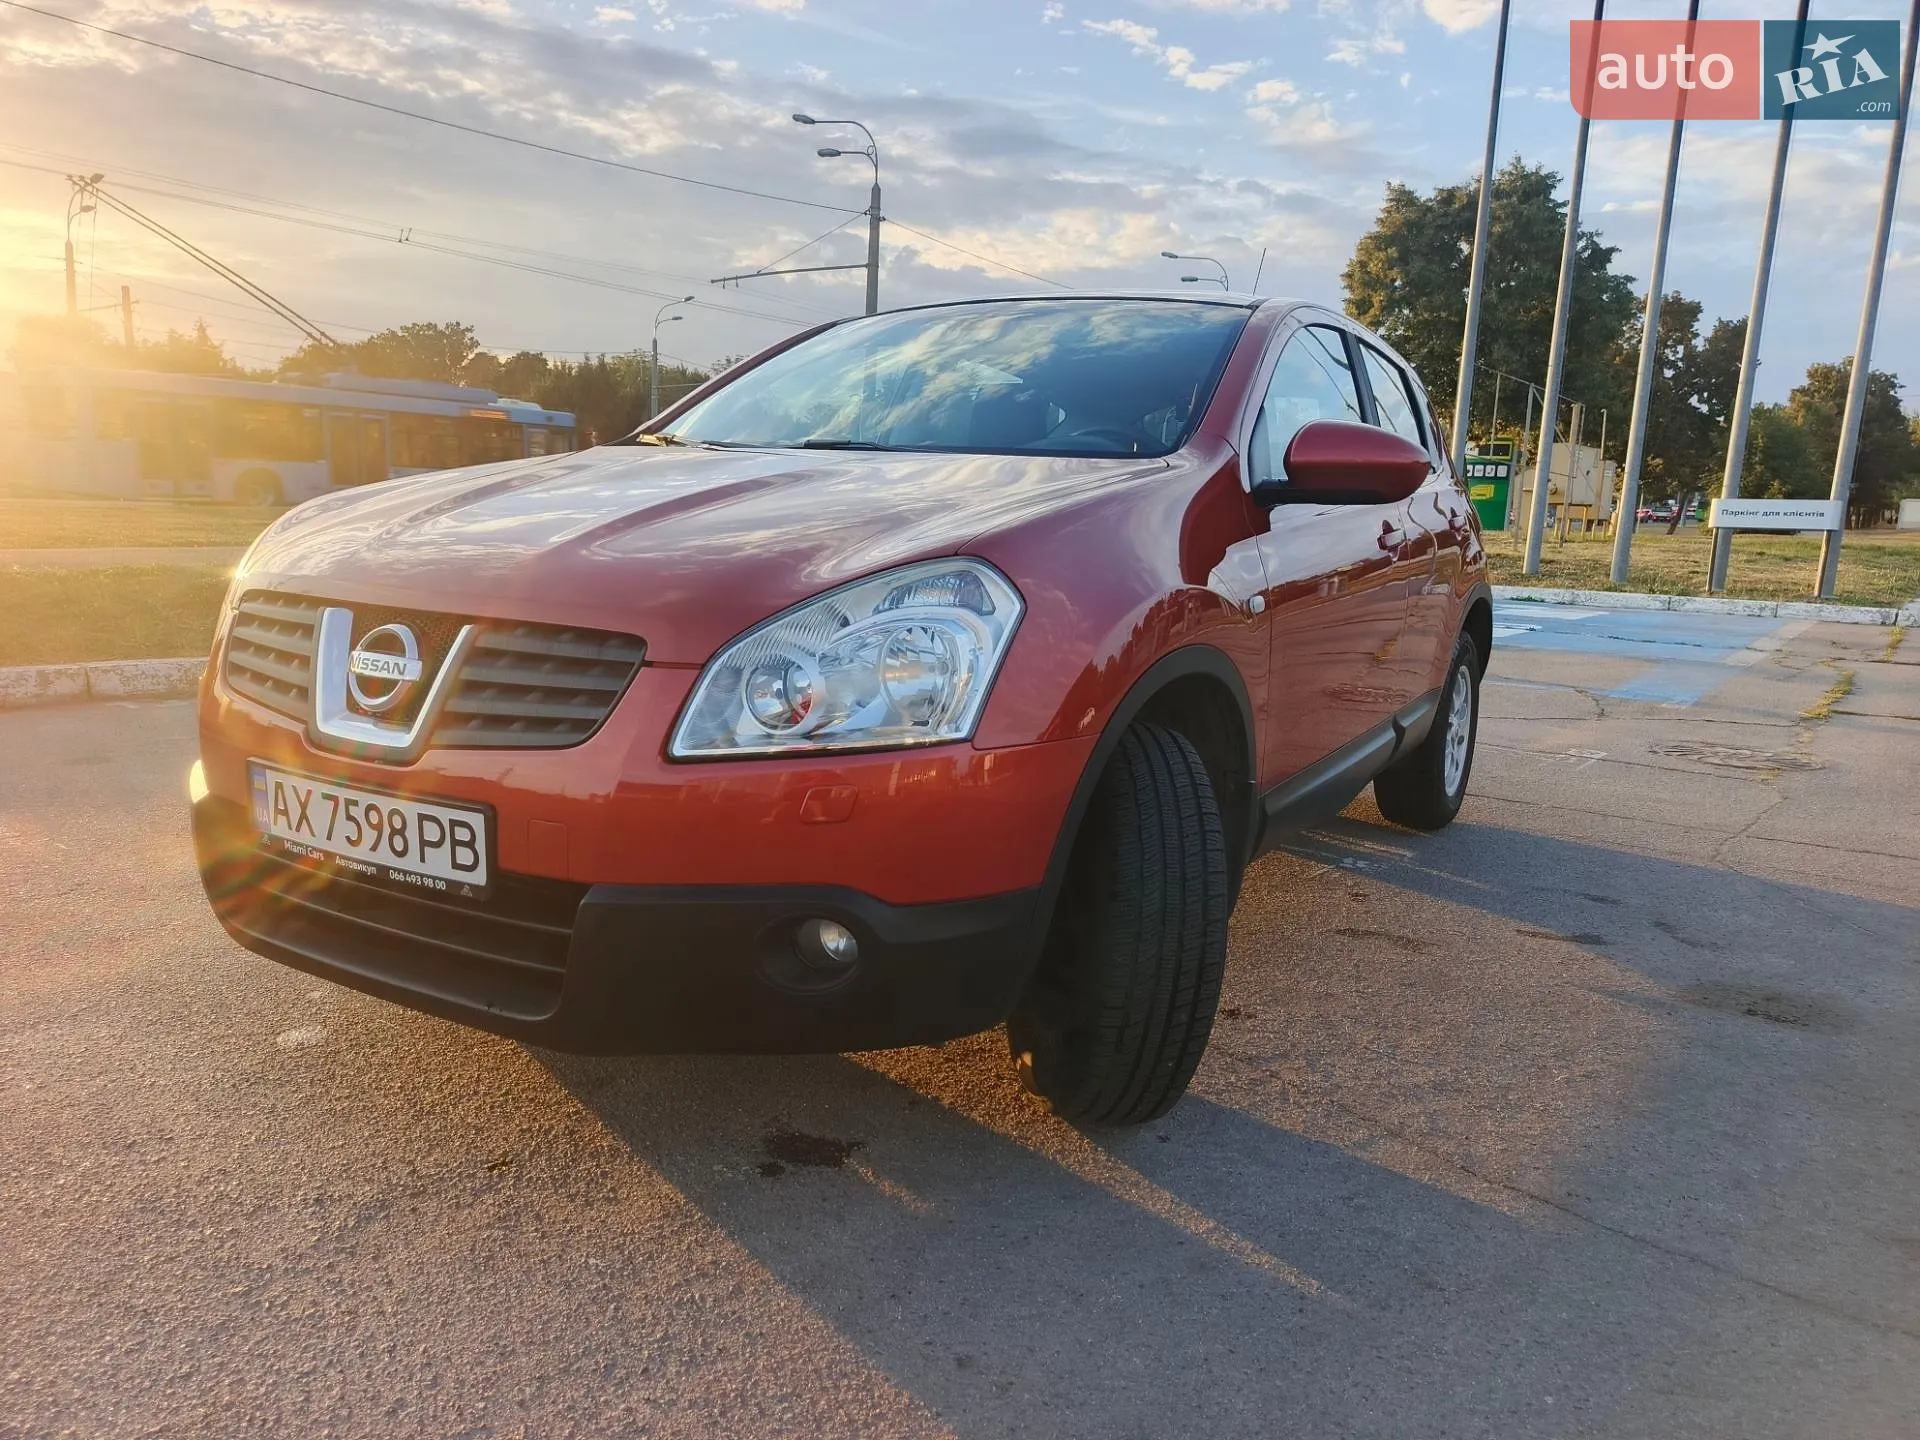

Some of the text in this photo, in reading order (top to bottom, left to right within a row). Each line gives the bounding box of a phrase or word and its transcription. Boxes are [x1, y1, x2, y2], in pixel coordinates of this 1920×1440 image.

[1721, 508, 1825, 518] Паркінг для клієнтів
[350, 652, 407, 676] NISSAN
[256, 807, 270, 825] UA
[273, 780, 480, 873] AX 7598 PB
[283, 839, 324, 861] Miami Cars
[335, 855, 377, 876] Автовикуп
[389, 869, 405, 881] 066
[406, 873, 422, 886] 493
[435, 880, 446, 891] 00
